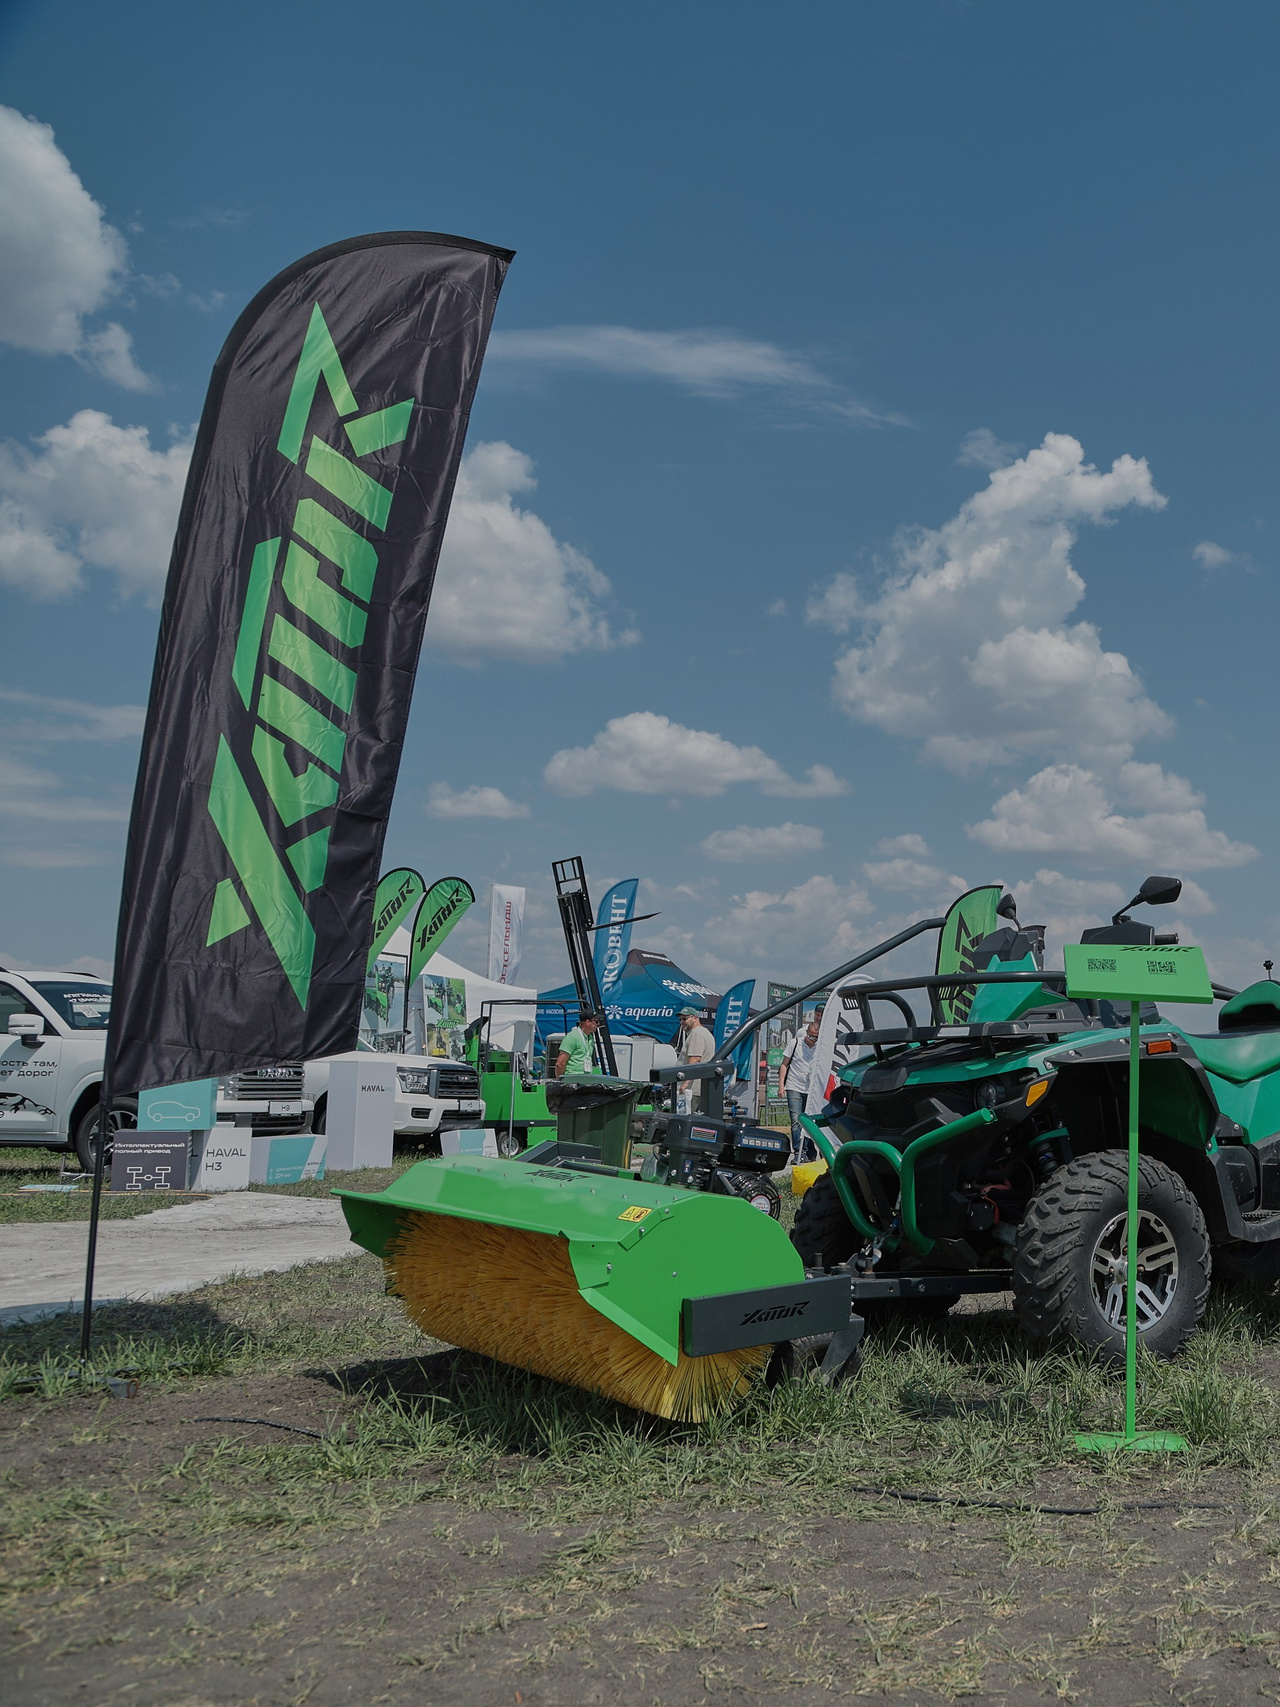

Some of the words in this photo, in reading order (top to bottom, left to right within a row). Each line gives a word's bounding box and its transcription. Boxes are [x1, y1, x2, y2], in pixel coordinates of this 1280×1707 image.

[624, 1005, 674, 1021] aquario
[33, 1060, 58, 1069] там,
[17, 1070, 54, 1078] дорог
[361, 1084, 385, 1092] HAVAL
[206, 1148, 247, 1158] HAVAL
[205, 1161, 222, 1171] H3
